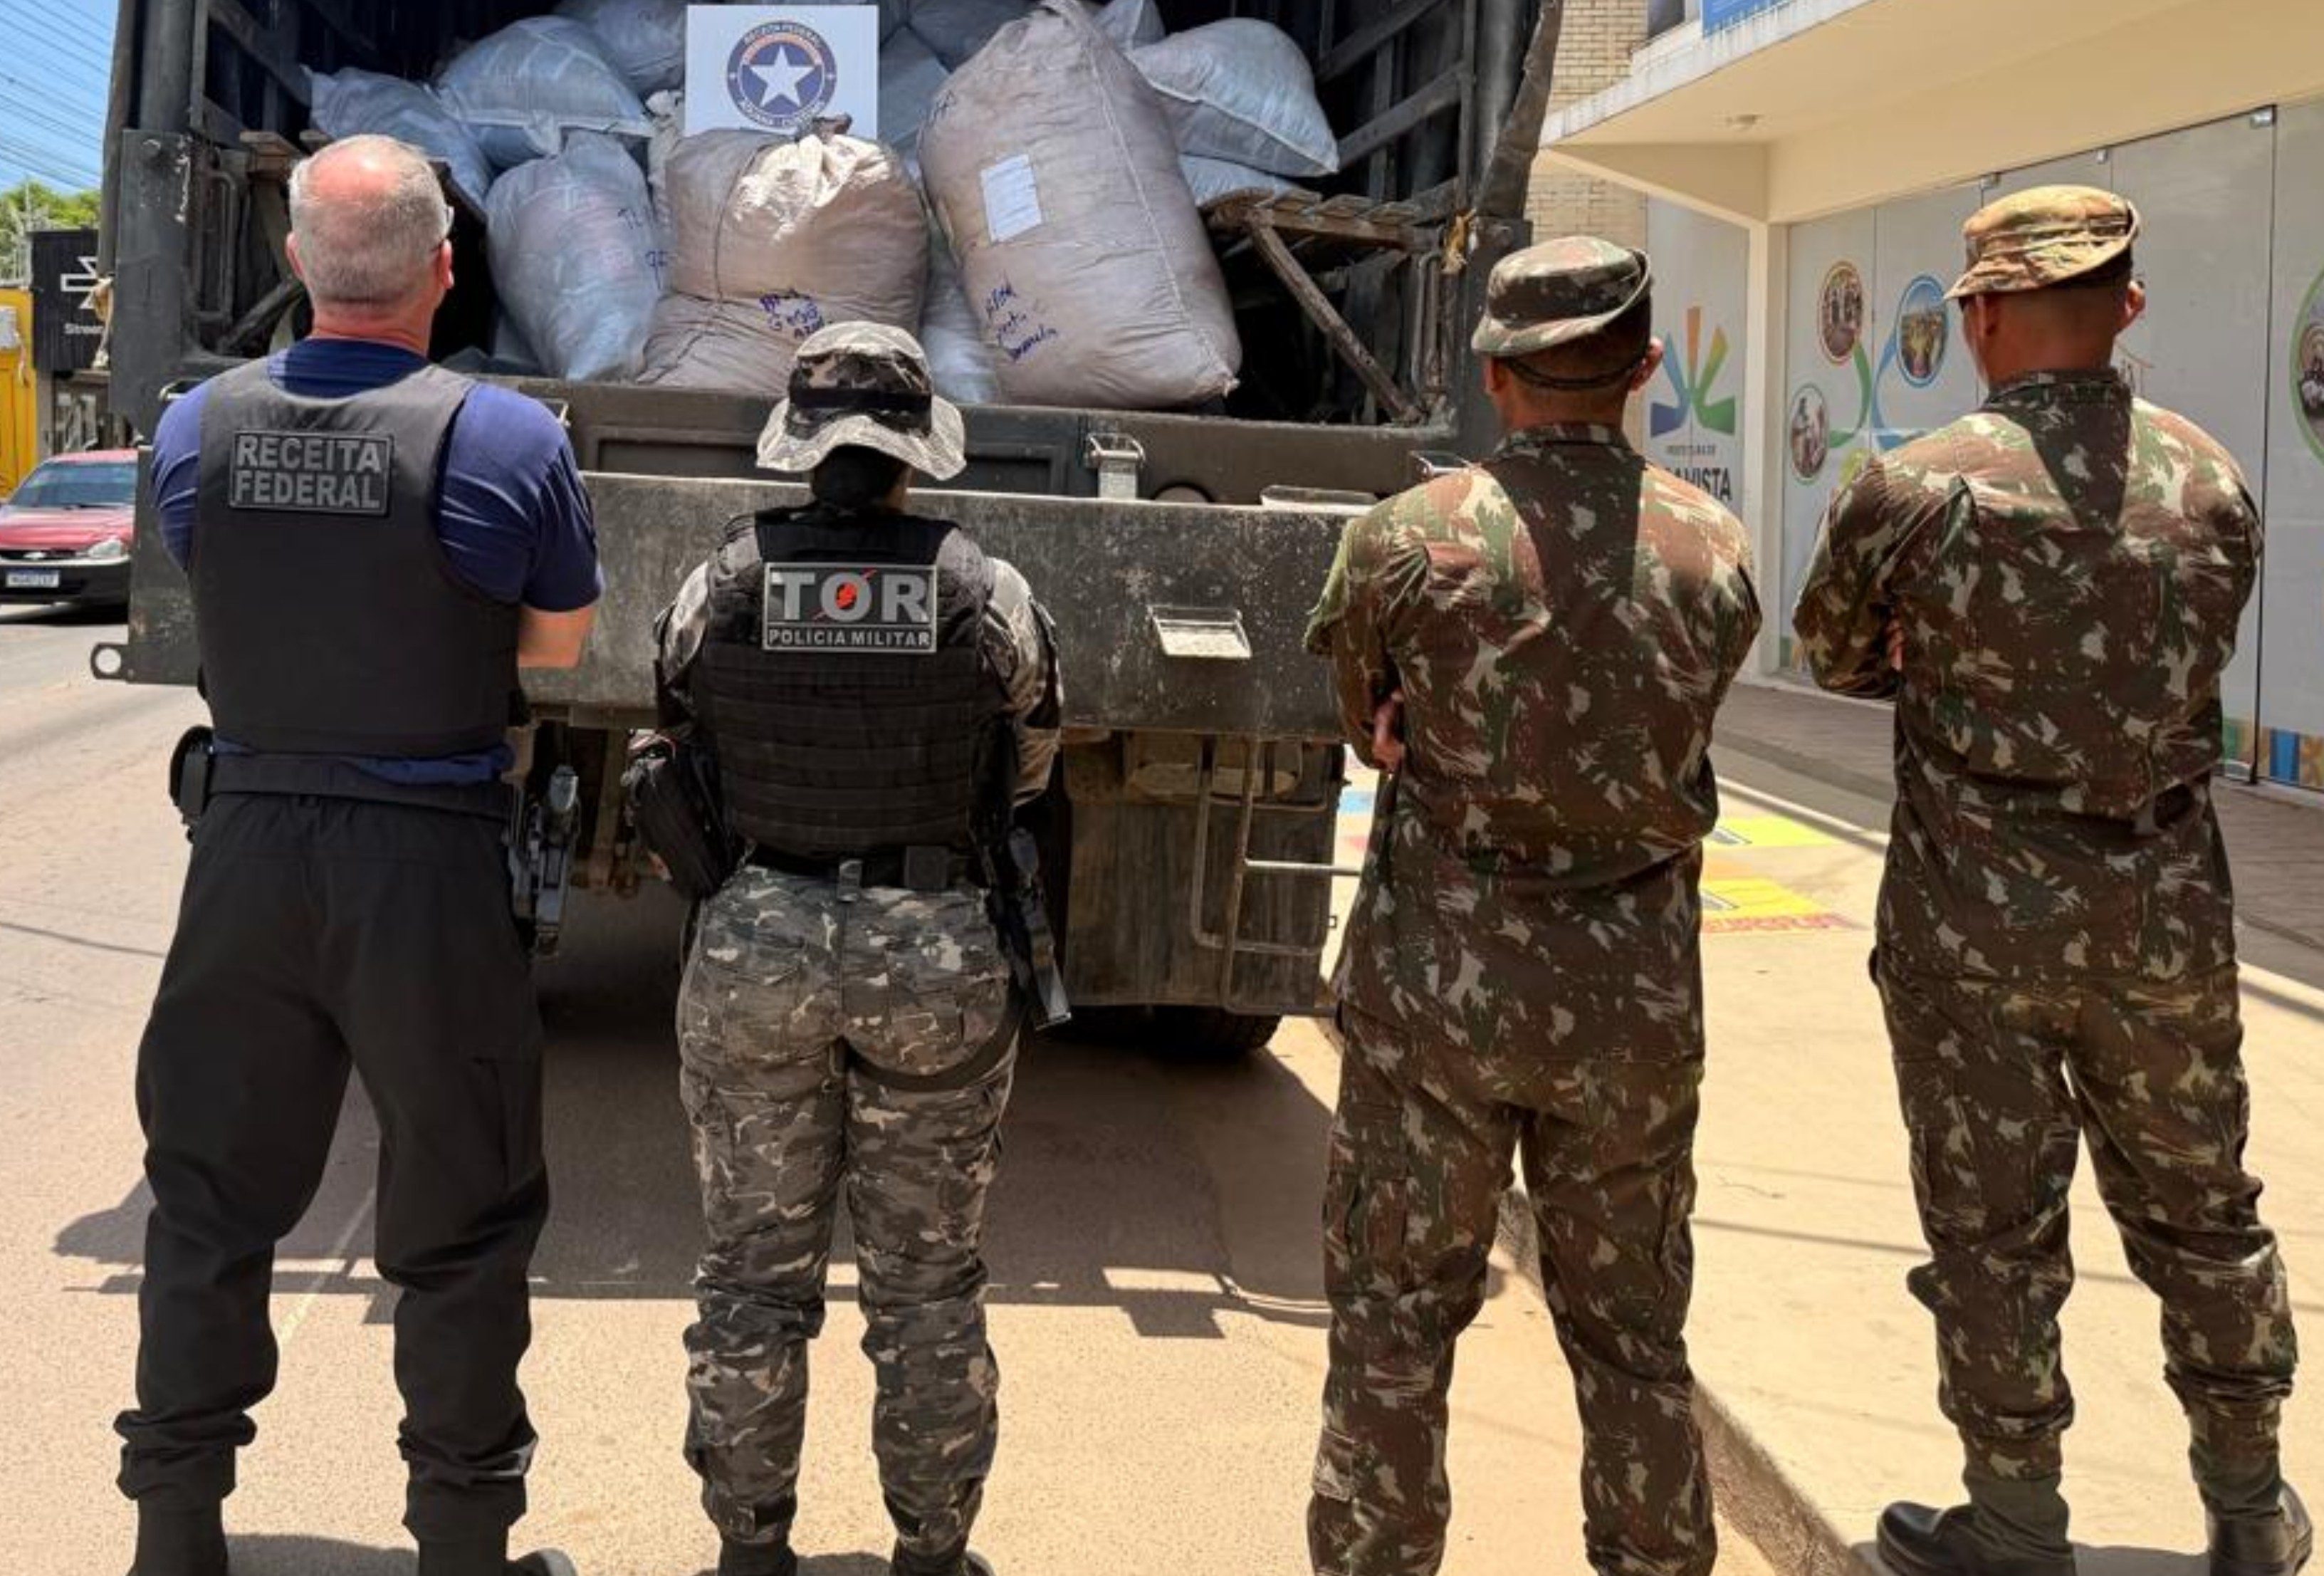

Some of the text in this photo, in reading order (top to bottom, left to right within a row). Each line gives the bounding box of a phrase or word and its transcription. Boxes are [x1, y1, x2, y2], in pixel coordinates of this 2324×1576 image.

[236, 434, 383, 474] RECEITA
[234, 469, 380, 508] FEDERAL
[771, 572, 930, 622] TOR
[852, 630, 931, 647] MILITAR
